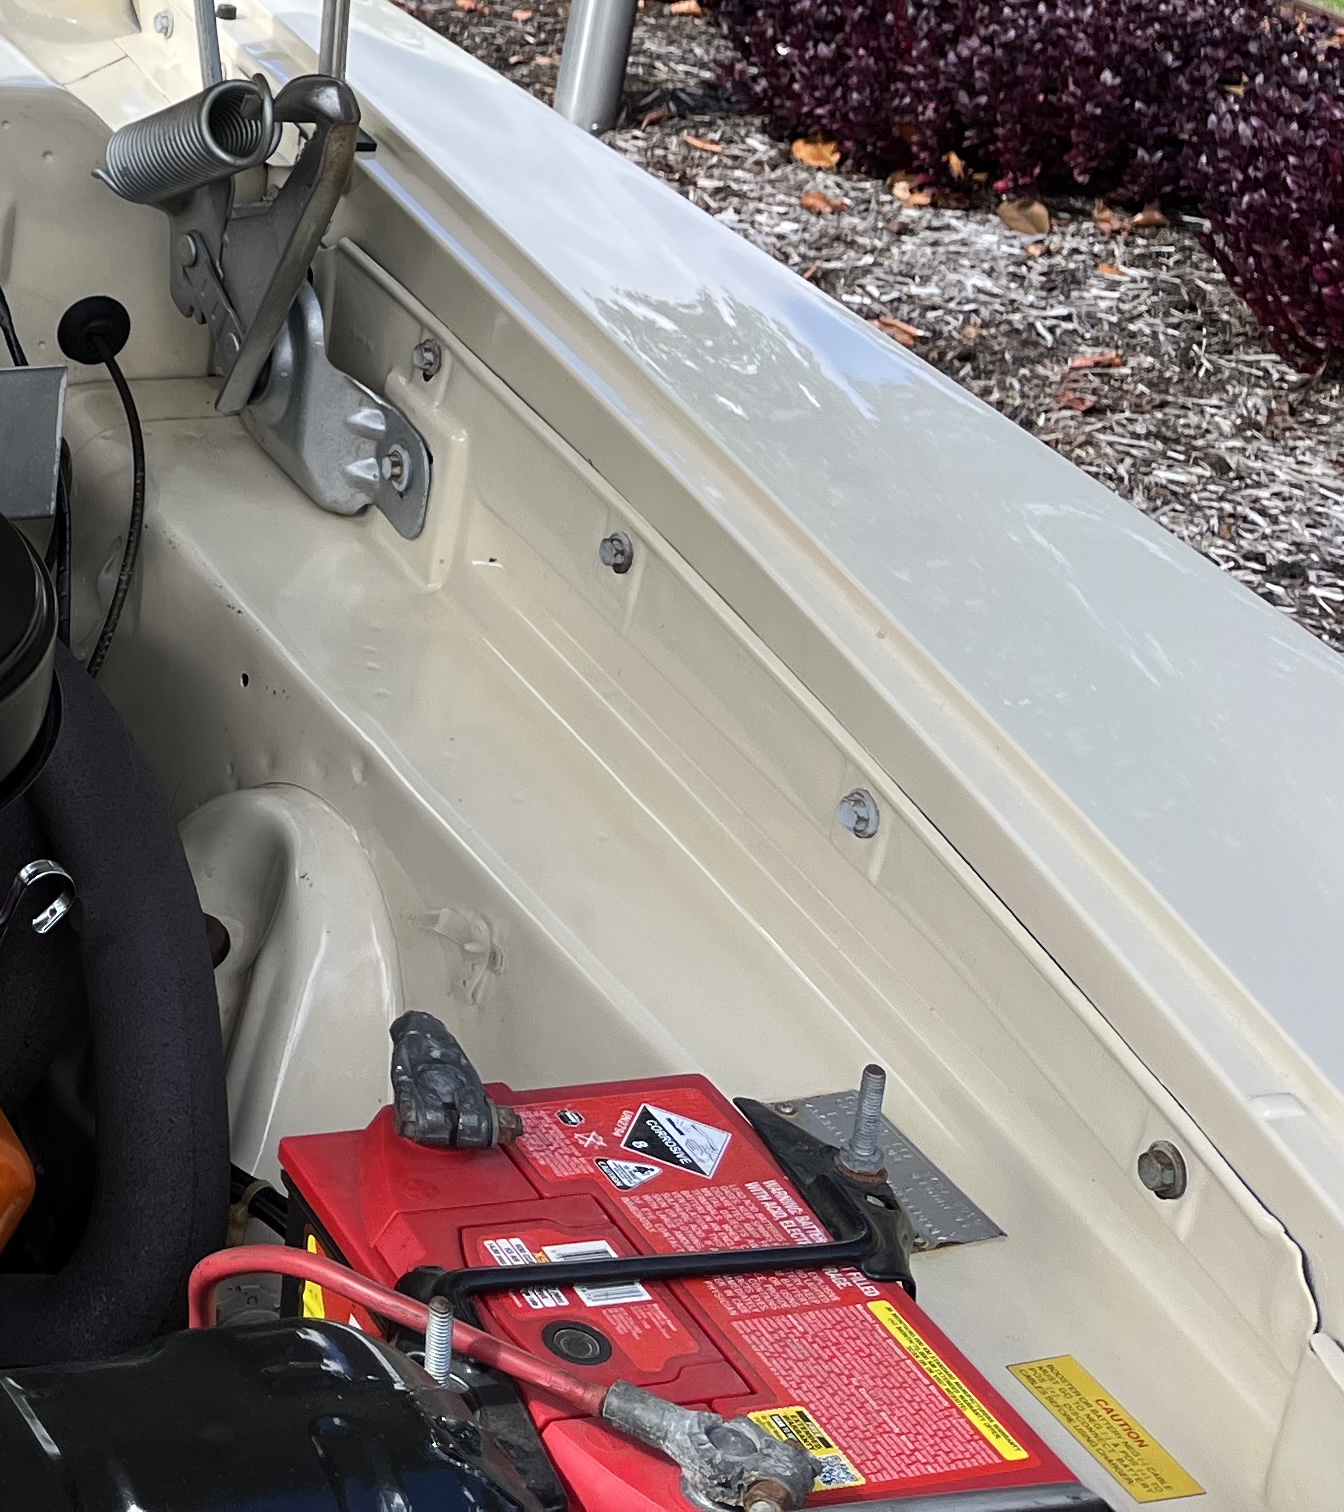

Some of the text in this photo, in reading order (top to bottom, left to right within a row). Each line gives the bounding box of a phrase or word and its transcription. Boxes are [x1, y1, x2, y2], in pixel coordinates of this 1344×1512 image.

[631, 1139, 648, 1150] 8
[645, 1118, 693, 1165] CORROSIVE
[651, 1223, 686, 1253] CONTACT
[742, 1181, 772, 1201] WITH
[777, 1219, 812, 1245] ELECT
[820, 1266, 853, 1289] RAGE
[793, 1214, 831, 1244] BATTER
[845, 1271, 881, 1297] FILLED
[806, 1271, 841, 1301] EXPLOSIVE
[780, 1414, 816, 1450] WARRANTY
[788, 1413, 823, 1449] EXTENDED
[1017, 1368, 1049, 1395] CABLES
[1044, 1396, 1077, 1423] BEFORE
[1072, 1425, 1099, 1447] USING
[1026, 1367, 1047, 1382] POS
[1061, 1403, 1117, 1453] DISCONNECT
[1114, 1457, 1156, 1493] BATTERY
[1036, 1365, 1060, 1385] MUST
[1056, 1387, 1074, 1399] GO
[1071, 1401, 1086, 1411] TO
[1082, 1413, 1104, 1429] NEG
[1118, 1450, 1140, 1466] POS
[1149, 1482, 1165, 1492] TO
[1044, 1364, 1082, 1396] BOOSTER
[1077, 1397, 1094, 1408] OR
[1088, 1409, 1125, 1439] BATTERY
[1120, 1441, 1142, 1457] NEG
[1144, 1466, 1175, 1490] CABLE
[1095, 1398, 1149, 1449] CAUTION
